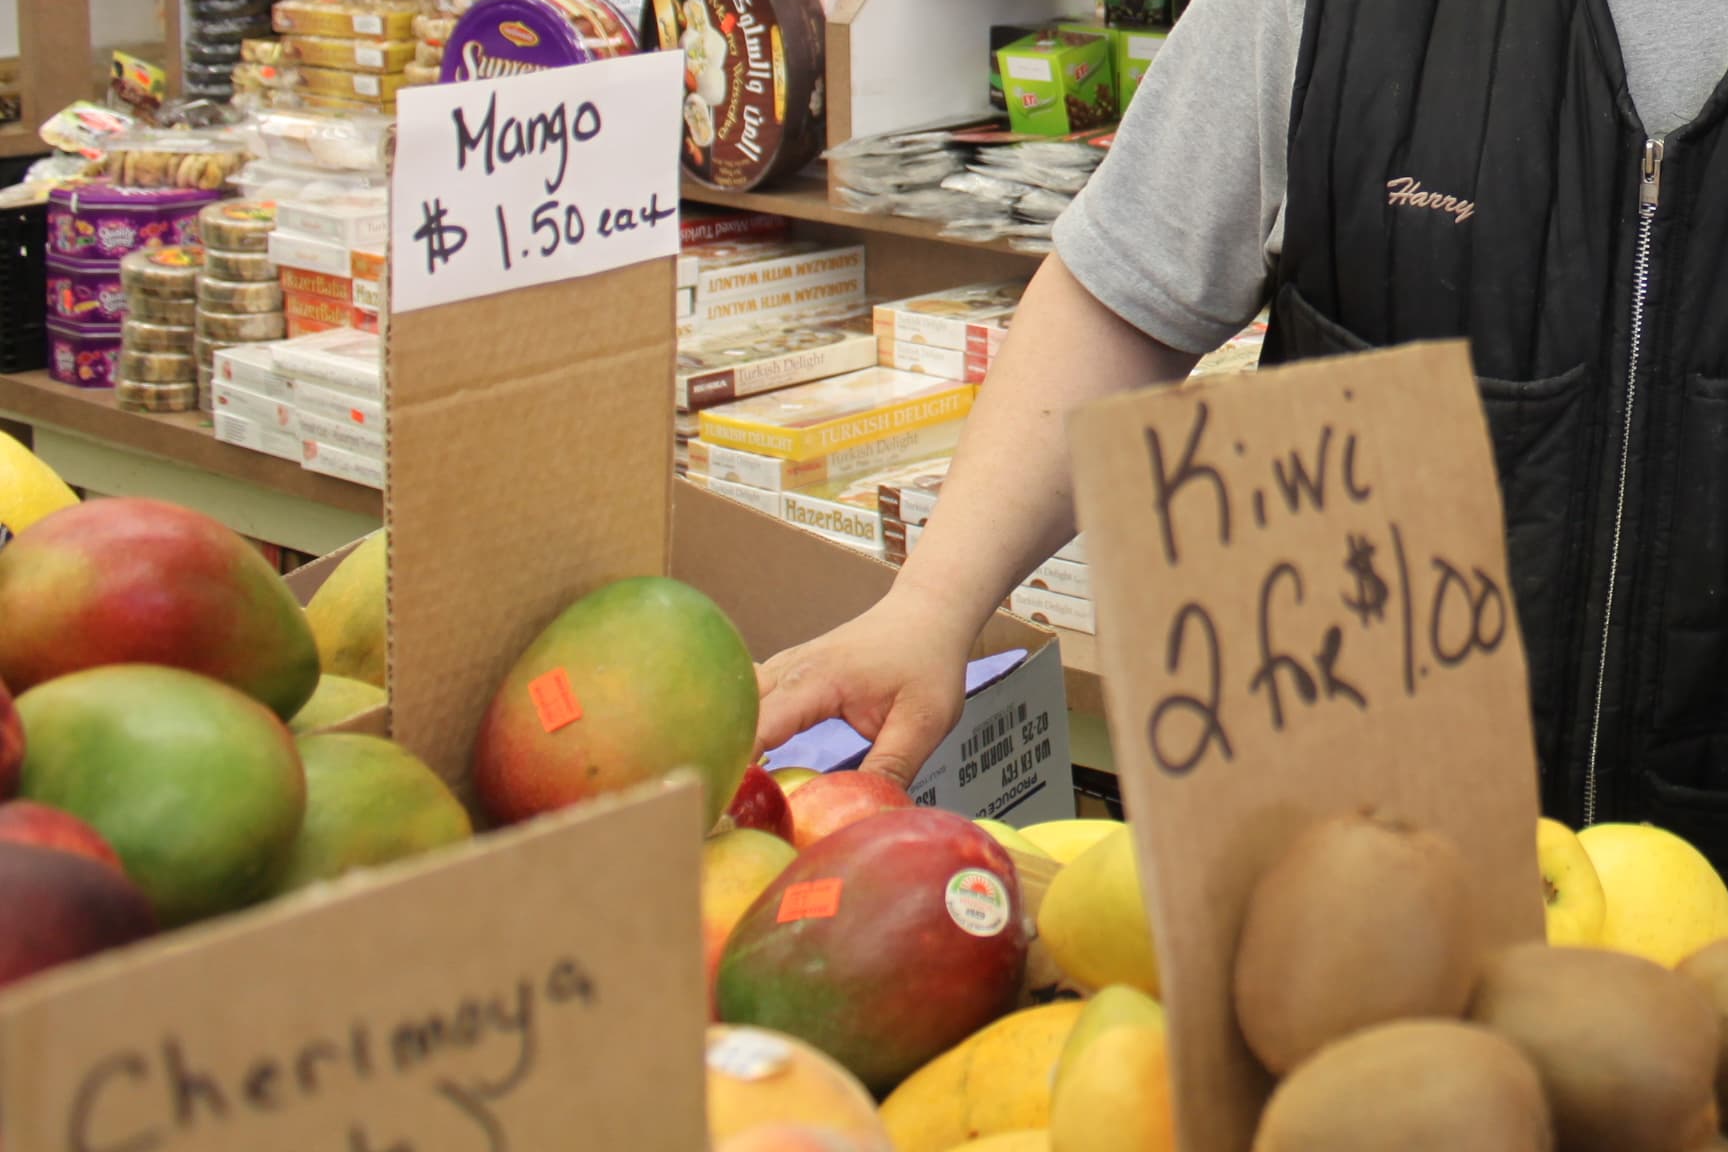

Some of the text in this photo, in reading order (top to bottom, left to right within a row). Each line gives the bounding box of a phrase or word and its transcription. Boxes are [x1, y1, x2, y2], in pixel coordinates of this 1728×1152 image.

[452, 91, 600, 194] Mango
[1387, 177, 1475, 224] Harry
[496, 200, 585, 270] 1.50
[709, 272, 760, 293] WALNUT
[762, 265, 793, 282] WITH
[708, 298, 758, 321] WALNUT
[760, 291, 792, 309] WITH
[738, 363, 781, 383] Turkish
[784, 353, 824, 370] Delight
[705, 423, 793, 451] TURKISH DELIGHT
[820, 396, 960, 446] TURKISH DELIGHT
[1144, 386, 1371, 566] Kiwi
[786, 499, 875, 541] HazerBaba
[1149, 604, 1234, 776] 2
[988, 772, 1038, 814] PRODUCE
